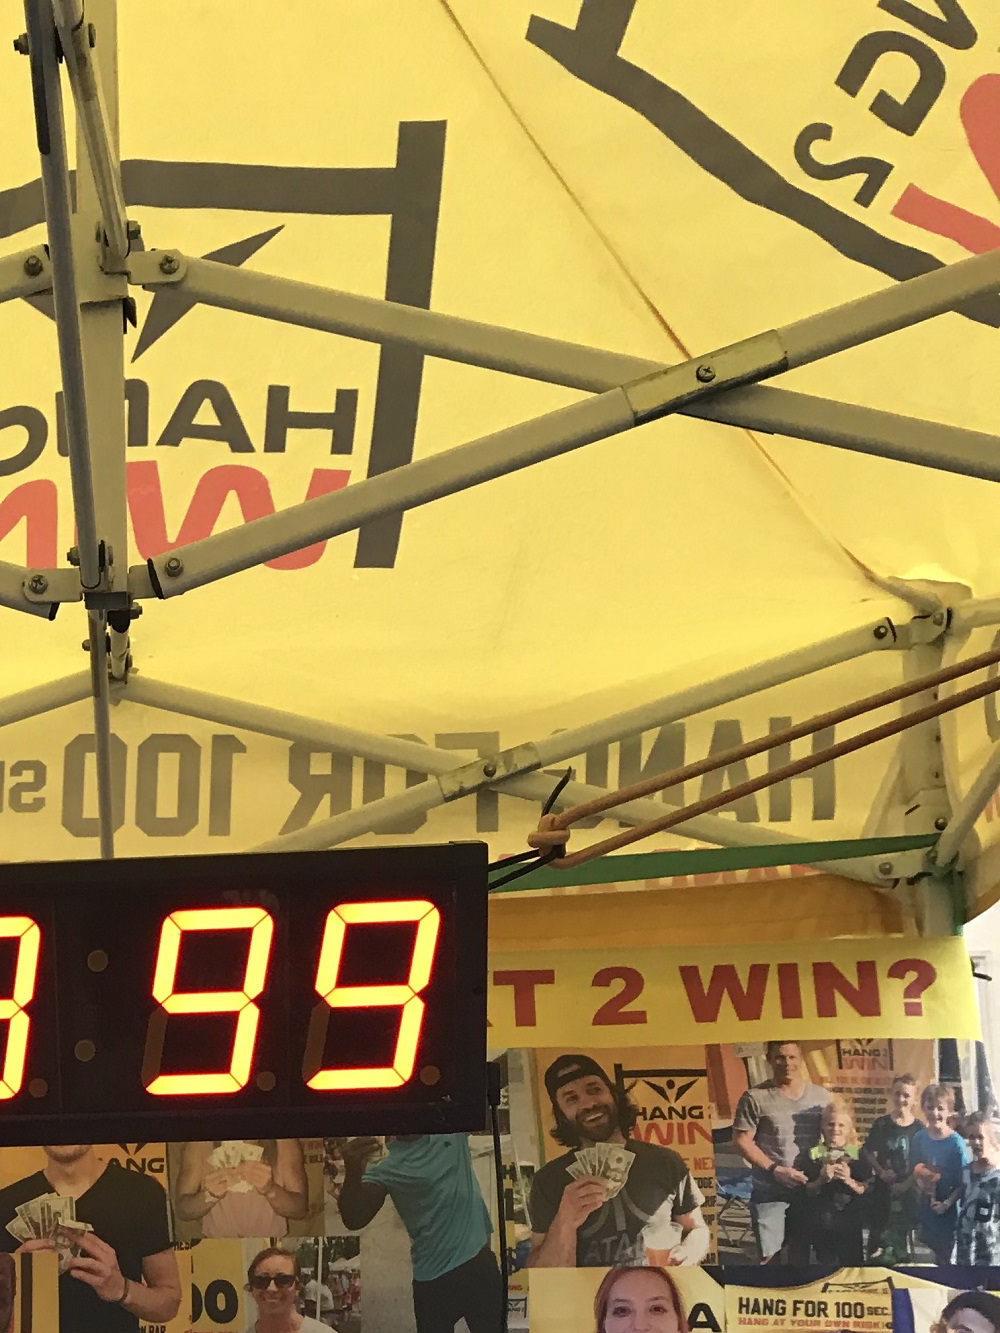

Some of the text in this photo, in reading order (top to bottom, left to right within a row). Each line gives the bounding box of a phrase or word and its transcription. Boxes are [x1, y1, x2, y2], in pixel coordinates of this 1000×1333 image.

[591, 966, 648, 1027] 2
[678, 957, 938, 1023] WIN?
[738, 1297, 787, 1316] HANG
[792, 1299, 828, 1318] FOR
[835, 1301, 865, 1319] 100
[791, 1319, 822, 1327] YOUR
